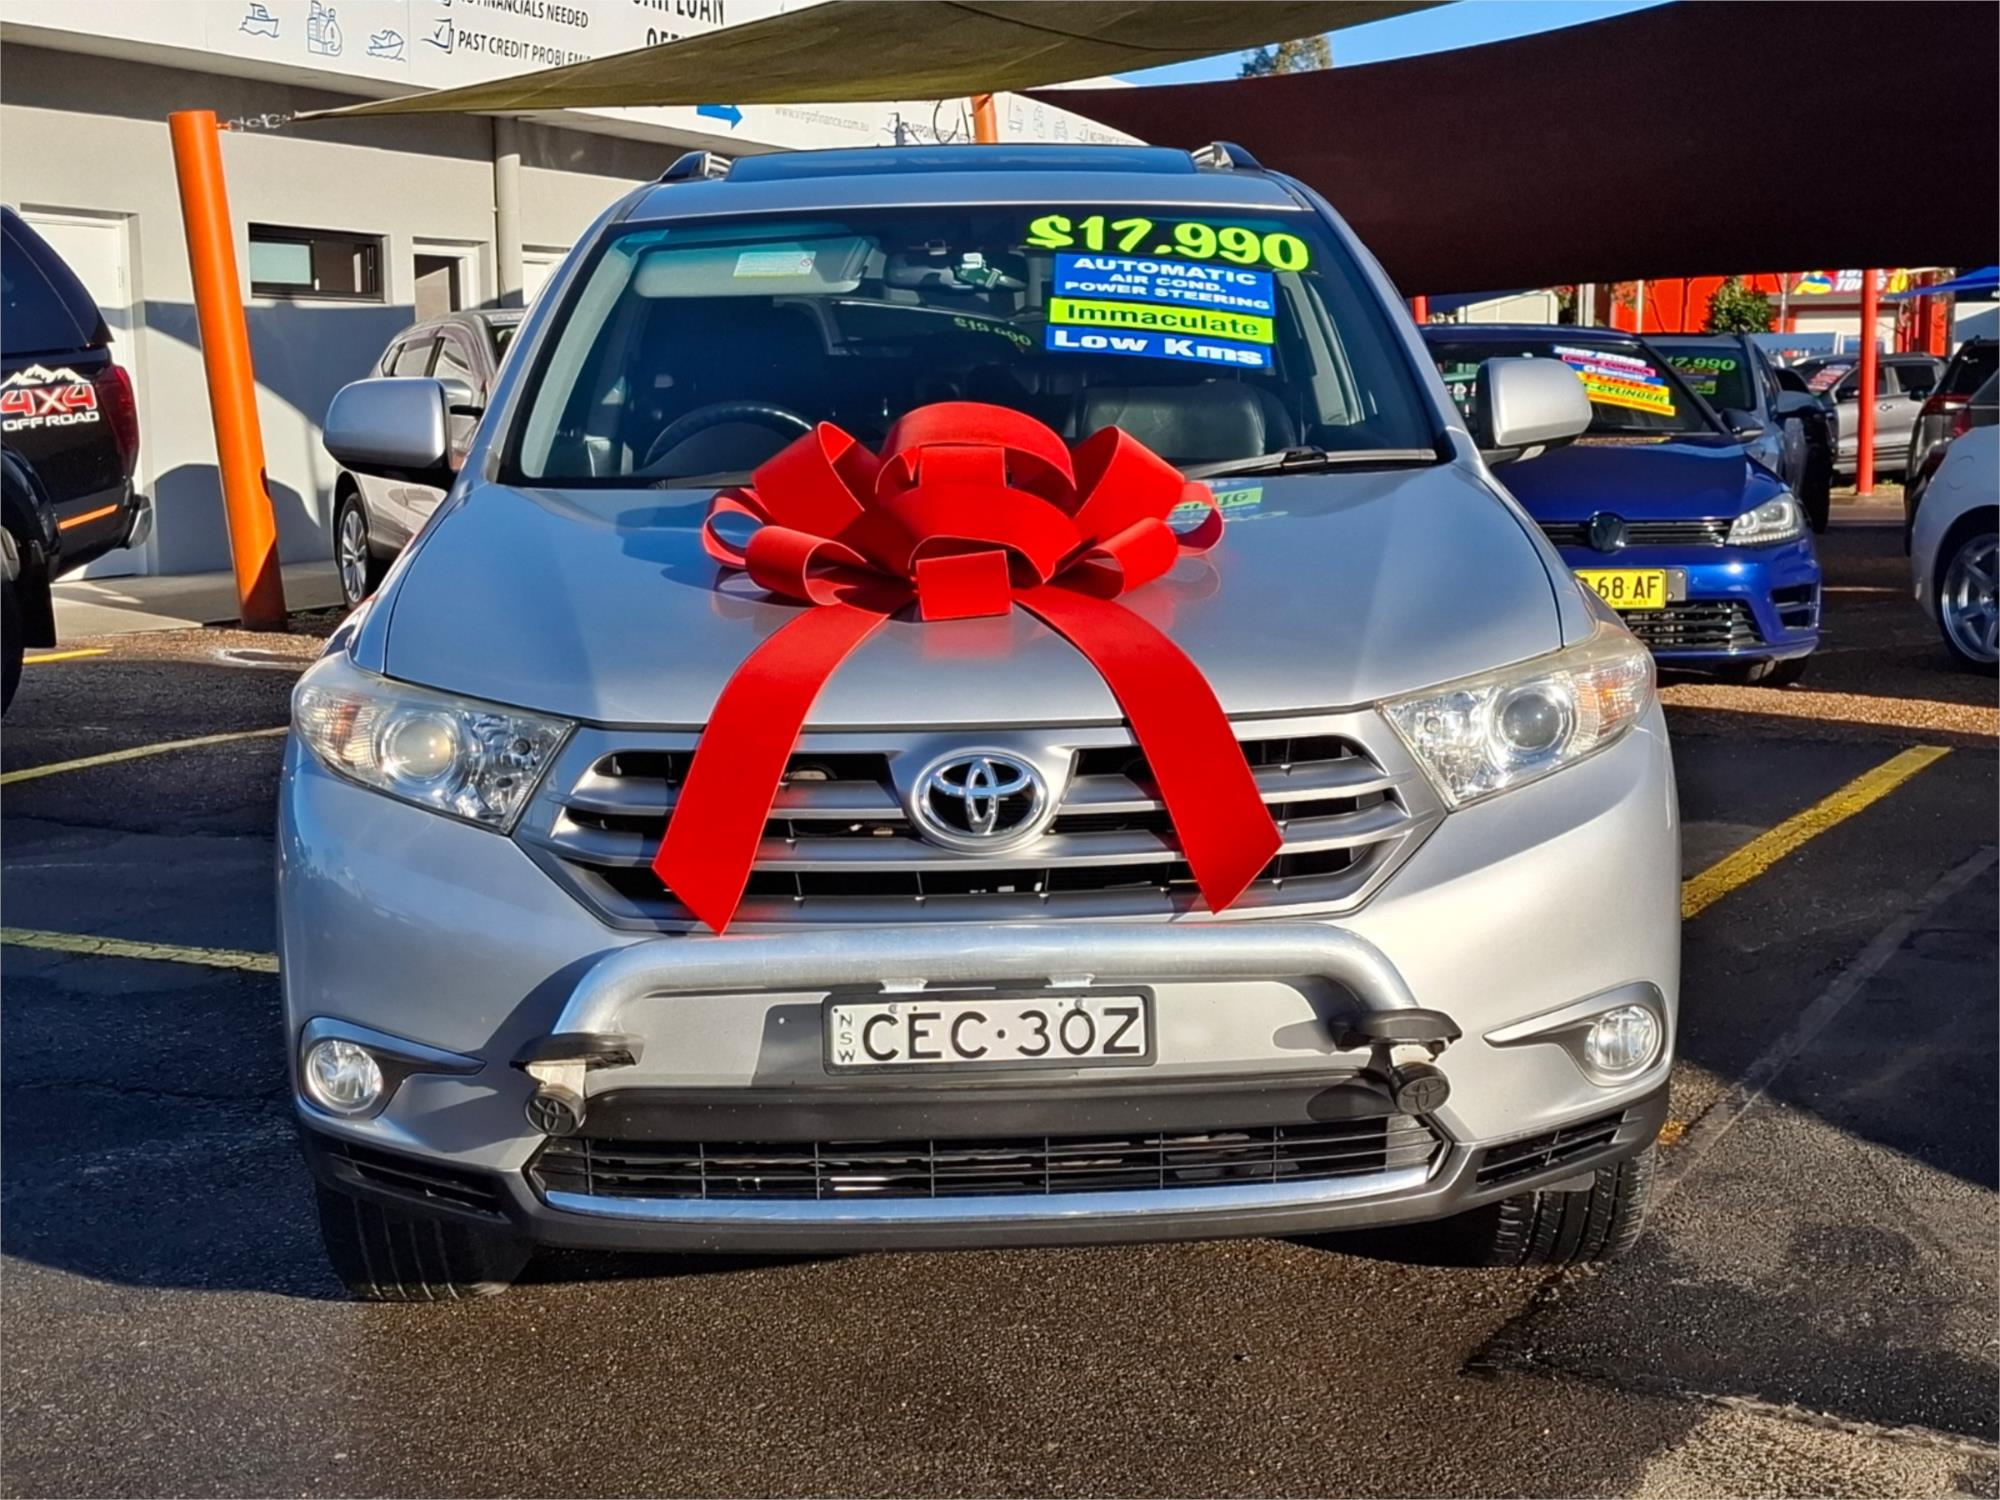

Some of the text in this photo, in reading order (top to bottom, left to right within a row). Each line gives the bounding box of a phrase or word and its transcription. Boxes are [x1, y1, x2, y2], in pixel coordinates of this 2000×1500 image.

[546, 4, 589, 29] NEEDED
[677, 0, 724, 26] LOAN
[458, 30, 487, 51] PAST
[489, 37, 530, 60] CREDIT
[1026, 214, 1309, 272] $17.990
[1073, 257, 1257, 286] AUTOMATIC
[1110, 273, 1226, 293] AIR COND.
[1064, 281, 1270, 311] POWER STEERING
[1067, 304, 1259, 337] Immaculate
[1054, 330, 1264, 366] Low Kms
[2, 411, 101, 432] OFF ROAD
